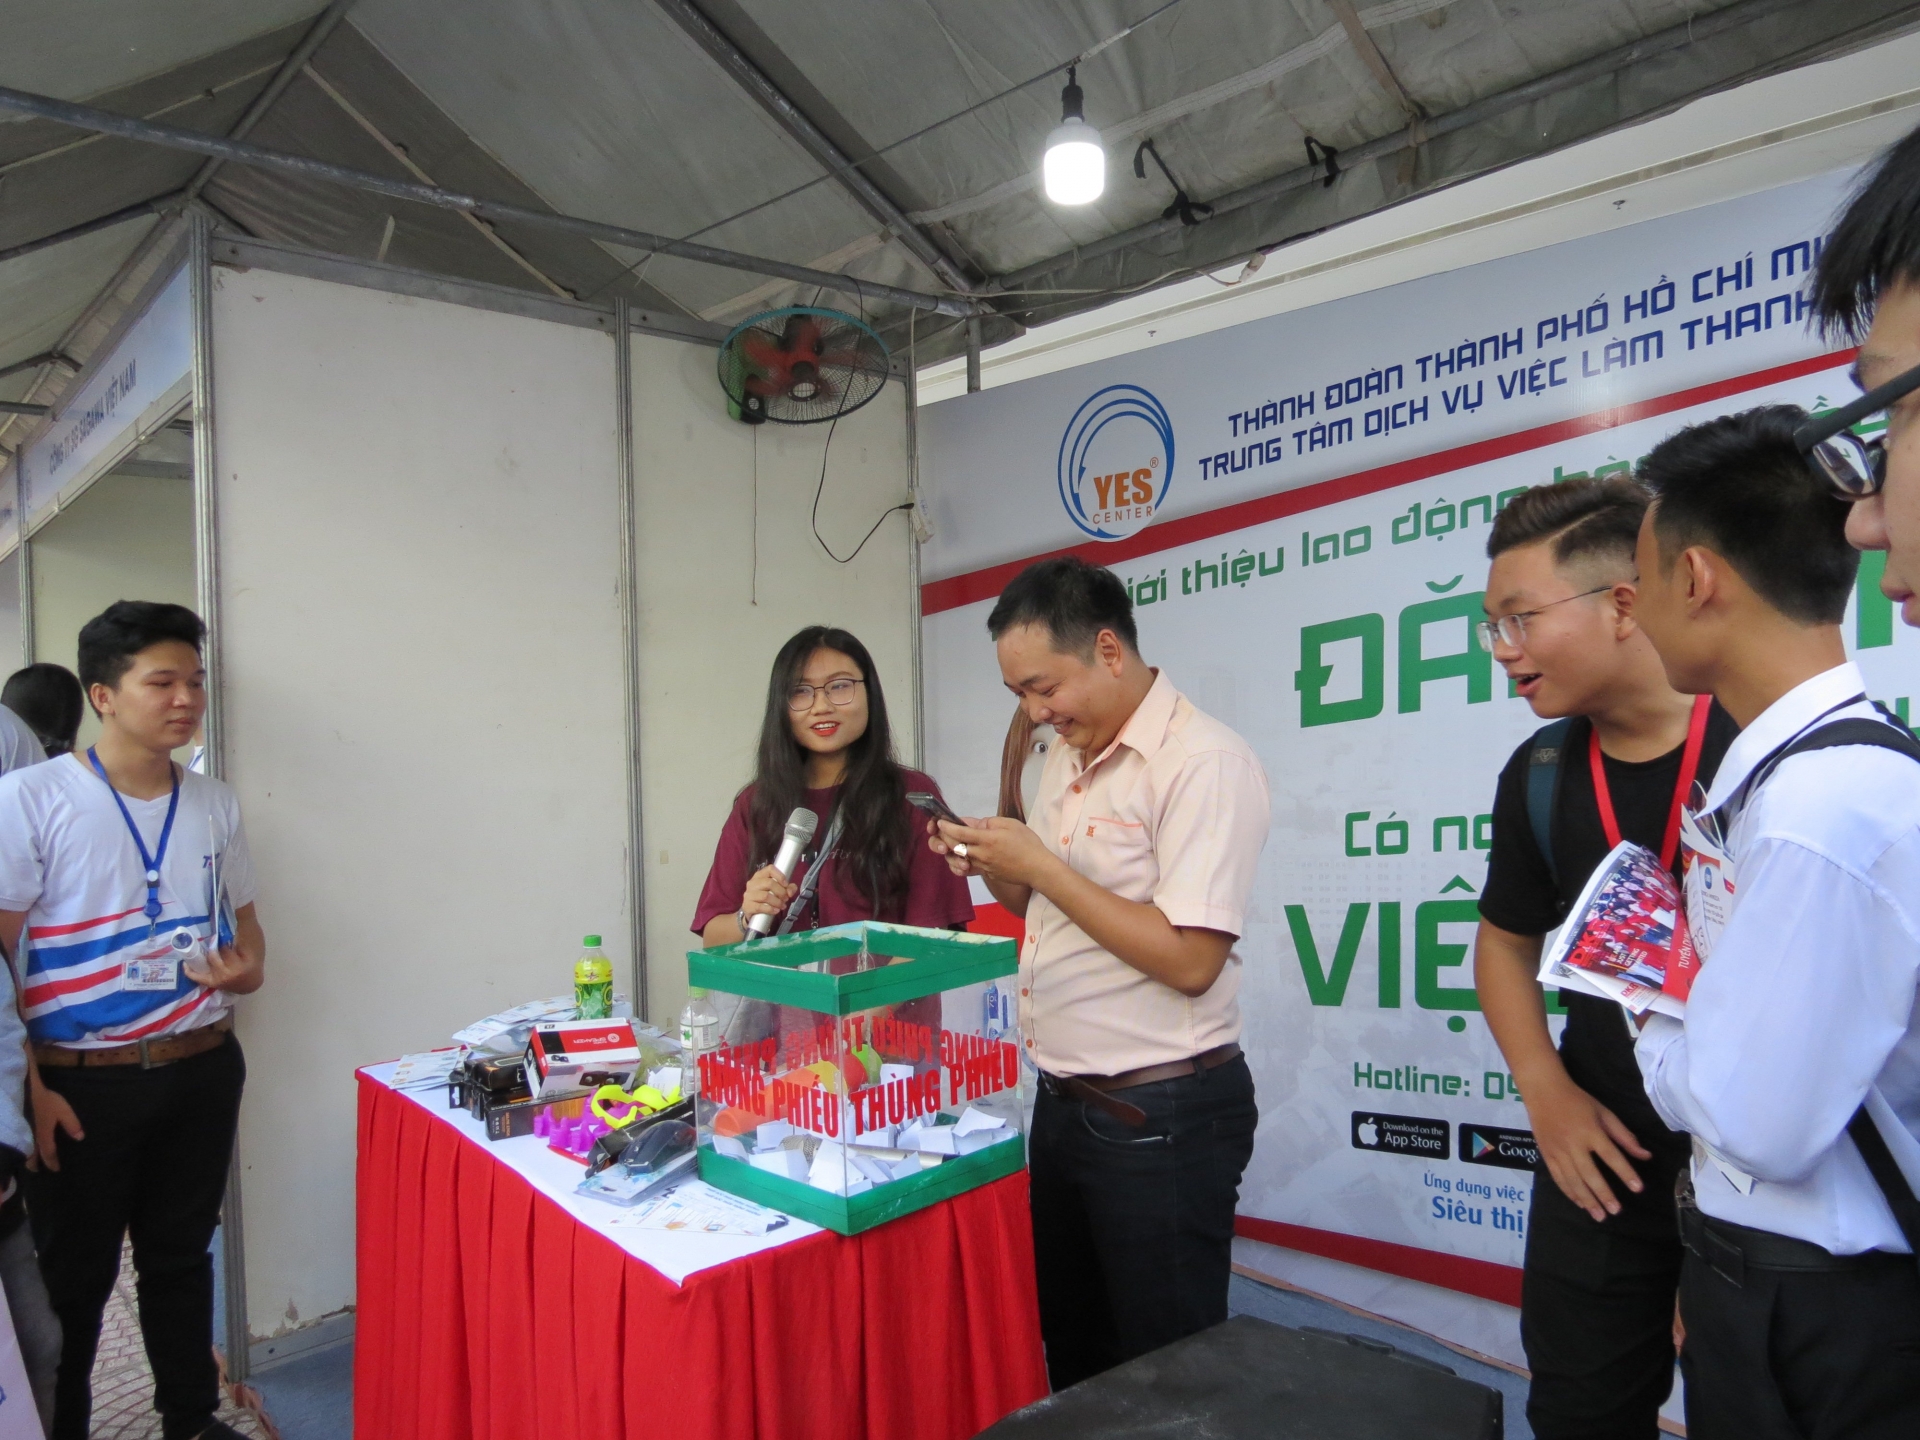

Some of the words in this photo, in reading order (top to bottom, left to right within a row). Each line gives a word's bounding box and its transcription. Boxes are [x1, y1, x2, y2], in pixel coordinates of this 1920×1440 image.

[1228, 391, 1315, 438] THÀNH
[1325, 364, 1403, 411] ĐOÀN
[1415, 327, 1523, 383] THÀNH
[1537, 293, 1609, 349] PHỐ
[1624, 274, 1676, 325] HỒ
[1692, 251, 1754, 304] CHÍ
[1771, 231, 1833, 281] MI
[120, 358, 137, 402] NAM
[1198, 437, 1282, 481] TRUNG
[1292, 416, 1353, 456] TÂM
[1364, 395, 1429, 438] DỊCH
[1441, 380, 1484, 415] VỤ
[1497, 355, 1568, 400] VIỆC
[1581, 330, 1664, 379] LÀM
[1093, 468, 1154, 510] YES
[1092, 505, 1155, 525] CENTER
[1126, 568, 1168, 607] iới
[1182, 547, 1285, 597] thiệu
[1301, 525, 1372, 567] lao
[1294, 574, 1526, 729] ĐĂ
[1345, 811, 1409, 858] Có
[1283, 874, 1568, 1034] VIỆ
[850, 1069, 941, 1137] THÙNG
[1354, 1061, 1470, 1097] Hotline:
[1484, 1071, 1525, 1102] 09
[773, 1074, 839, 1138] PHIẾU
[1382, 1121, 1419, 1134] Download
[1419, 1128, 1430, 1136] on
[1431, 1126, 1444, 1136] the
[1384, 1132, 1409, 1148] App
[1411, 1135, 1442, 1150] Store
[1424, 1169, 1451, 1192] Ứng
[1455, 1178, 1491, 1200] dụng
[1495, 1186, 1525, 1204] việc
[1432, 1196, 1483, 1226] Siêu
[1490, 1206, 1524, 1239] thị
